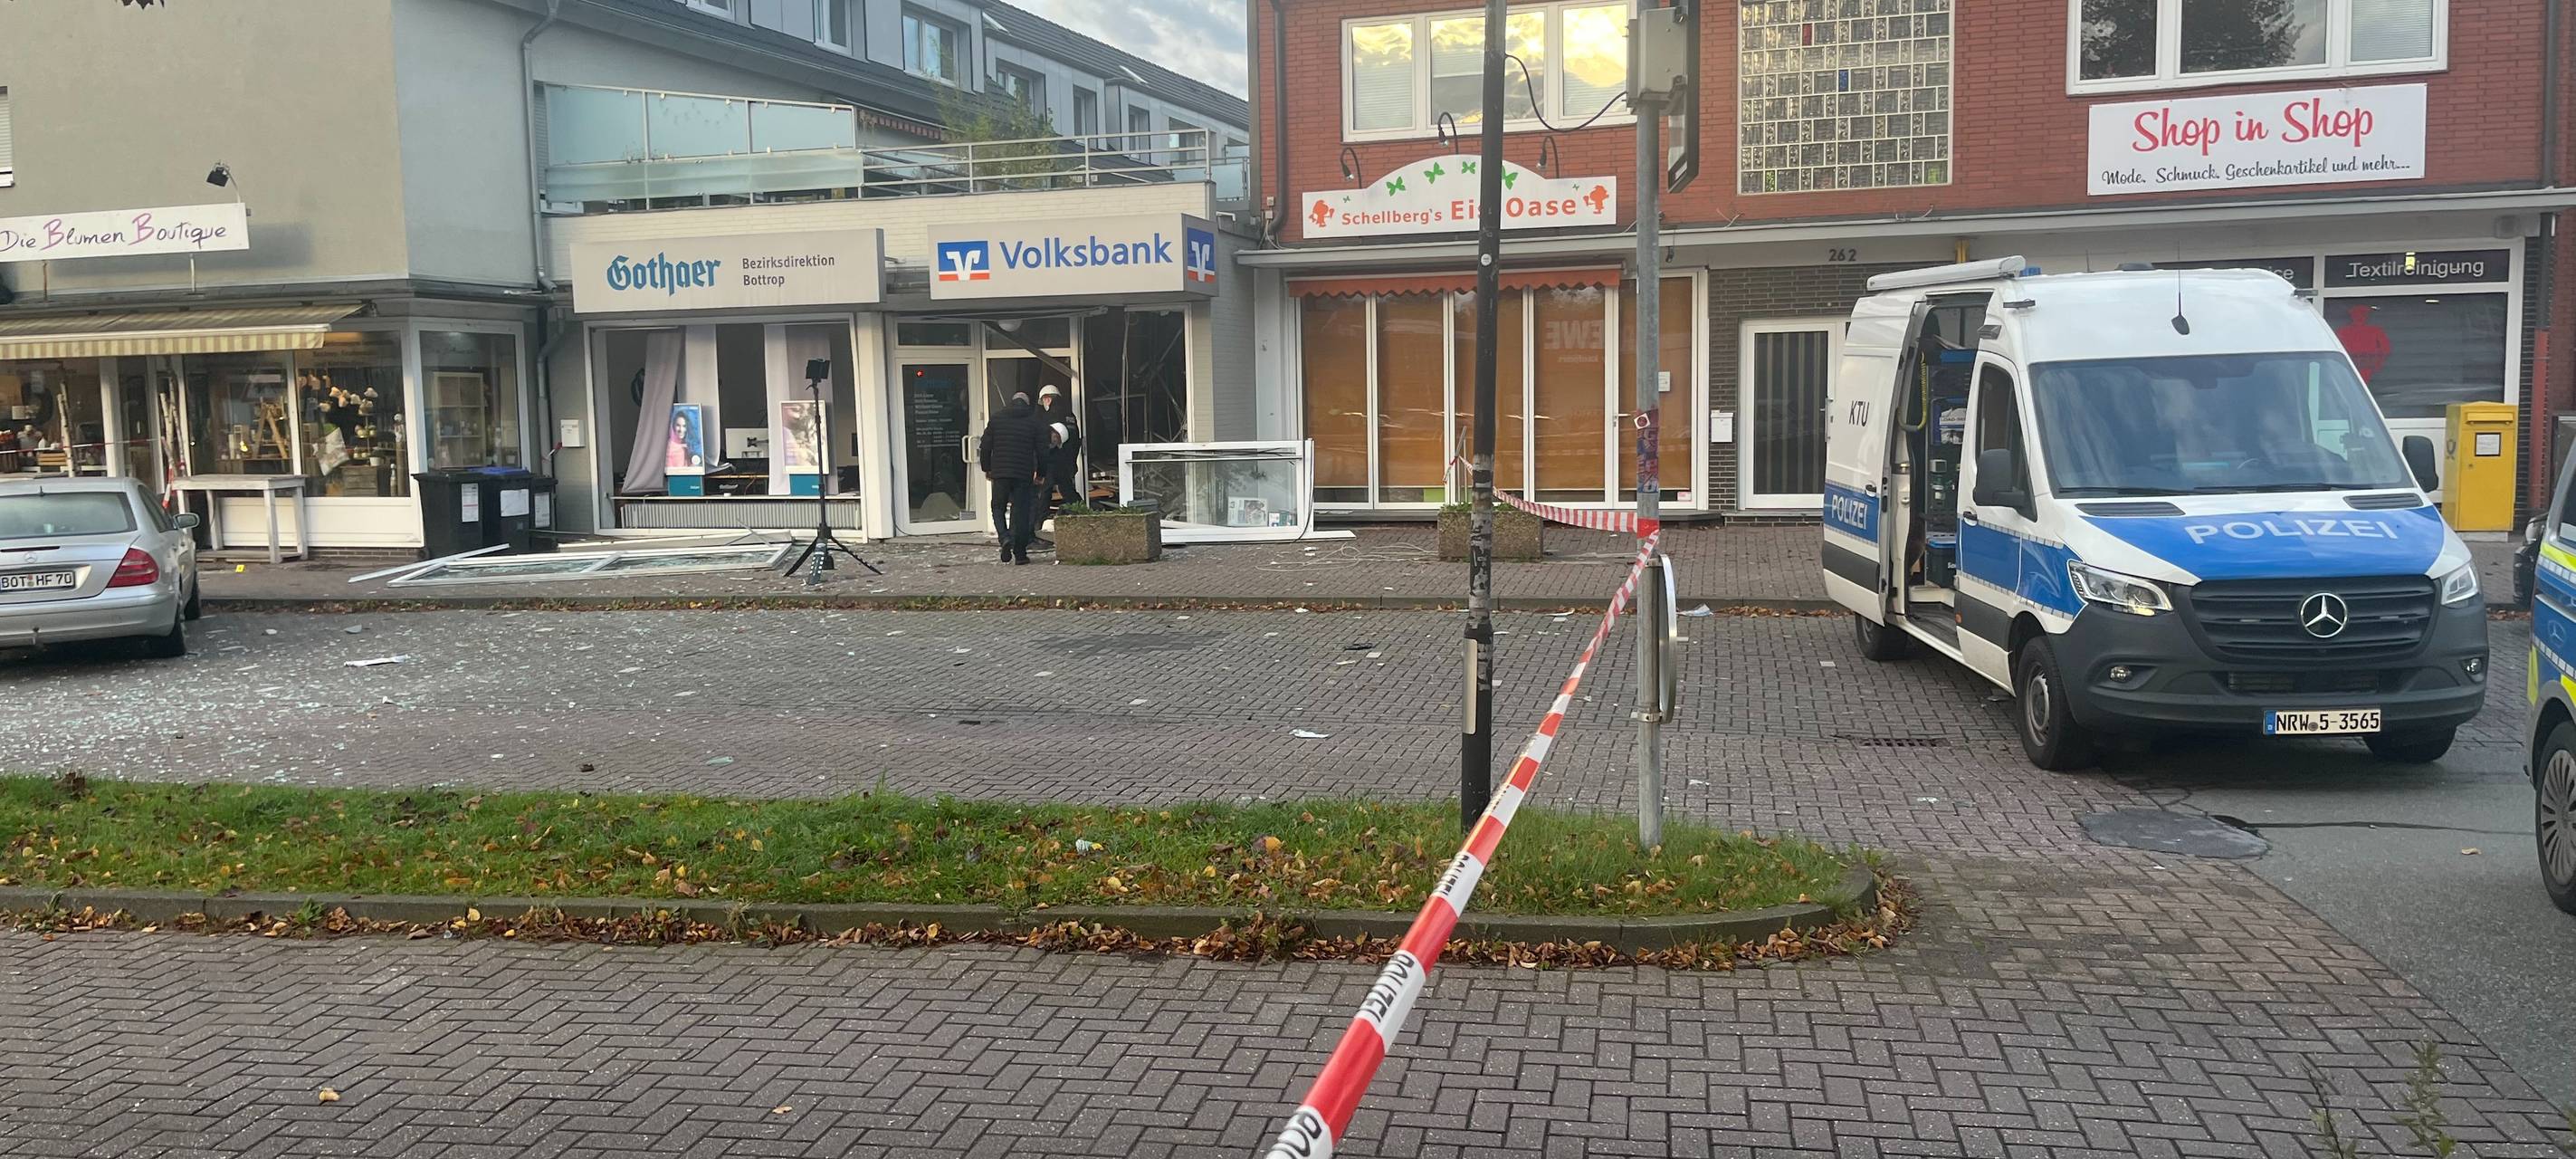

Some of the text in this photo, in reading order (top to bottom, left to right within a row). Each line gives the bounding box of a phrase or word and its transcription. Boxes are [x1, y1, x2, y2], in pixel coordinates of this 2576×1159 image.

[2132, 97, 2373, 156] Shop in Shop
[2225, 158, 2328, 179] Geschenkartikel
[2333, 156, 2357, 173] und
[1340, 196, 1577, 226] Schellberg's Ei Oase
[0, 213, 226, 252] Die Blumen Boutique
[742, 254, 835, 270] Bezirksdirektion
[998, 232, 1173, 270] Volksbank
[1828, 249, 1857, 263] 262
[606, 251, 721, 297] Gothaer
[743, 273, 785, 288] Bottrop
[2349, 259, 2485, 278] Textilreinigung
[1849, 400, 1870, 426] KTU
[1831, 494, 1868, 530] POLIZEI
[2184, 519, 2398, 544] POLIZEI
[1, 573, 72, 588] BOT HF 70
[2275, 714, 2310, 732] NRW
